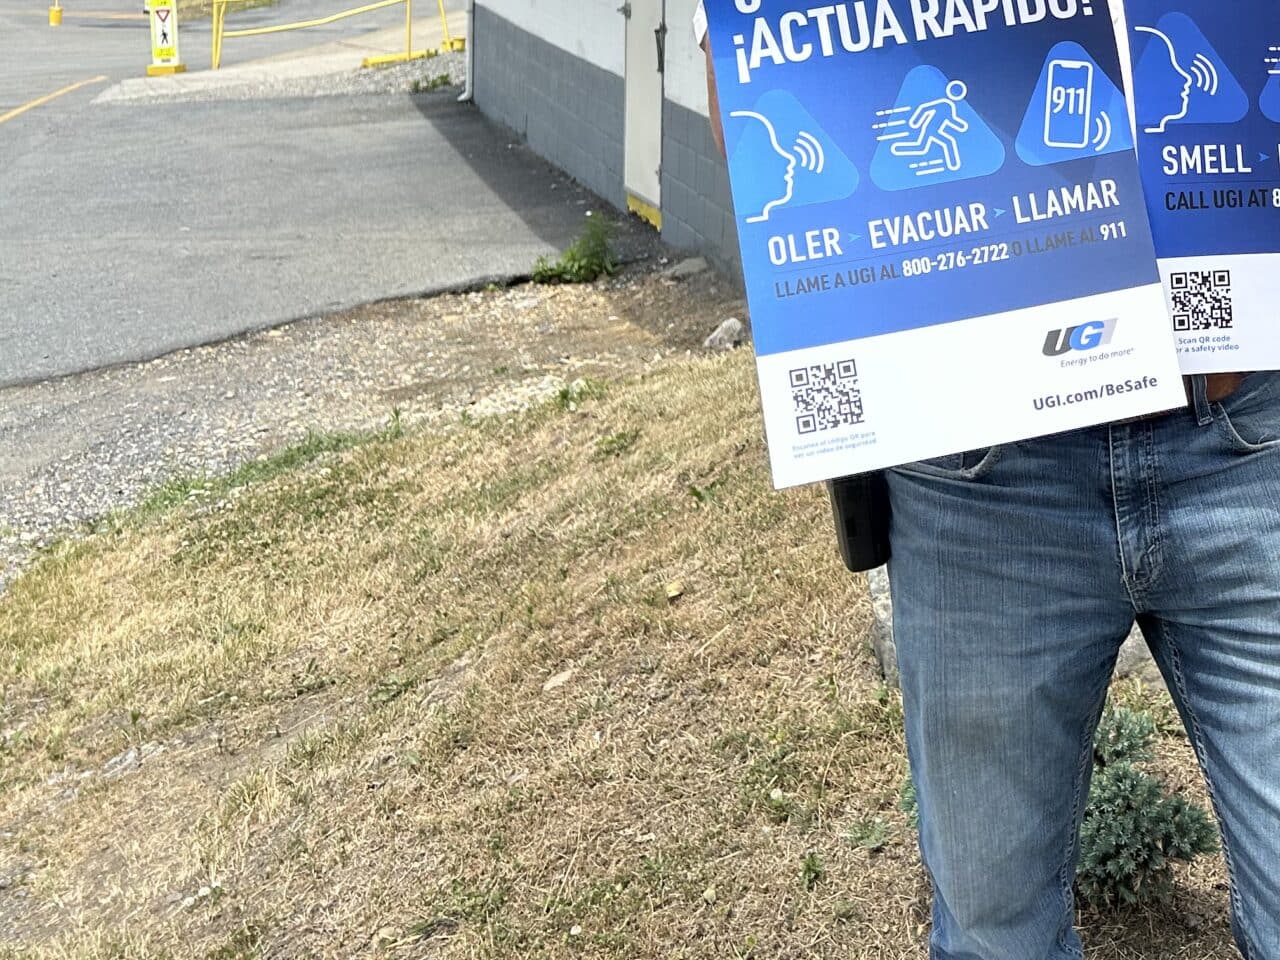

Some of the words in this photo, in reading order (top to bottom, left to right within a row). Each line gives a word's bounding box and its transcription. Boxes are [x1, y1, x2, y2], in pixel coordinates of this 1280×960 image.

[1052, 85, 1086, 116] 911
[1162, 143, 1252, 175] SMELL
[1165, 191, 1209, 210] CALL
[1213, 190, 1243, 208] UGI
[1248, 189, 1268, 208] AT
[768, 228, 842, 266] OLER
[868, 203, 989, 249] EVACUAR
[1012, 179, 1120, 224] LLAMAR
[775, 274, 831, 298] LLAME
[834, 272, 846, 289] A
[848, 266, 876, 286] UGI
[880, 264, 900, 280] AL
[902, 243, 1009, 277] 800-276-2722
[1012, 241, 1023, 256] O
[1026, 231, 1076, 254] LLAME
[1079, 226, 1097, 242] AL
[1100, 221, 1127, 240] 911
[1042, 318, 1118, 356] UGI
[1192, 345, 1216, 353] safety
[1217, 343, 1240, 351] video
[1199, 336, 1210, 344] QR
[1060, 357, 1088, 368] Energy
[1089, 354, 1097, 362] to
[1099, 352, 1109, 360] do
[1110, 348, 1134, 358] more
[1033, 376, 1158, 411] UGI.com/BeSafe
